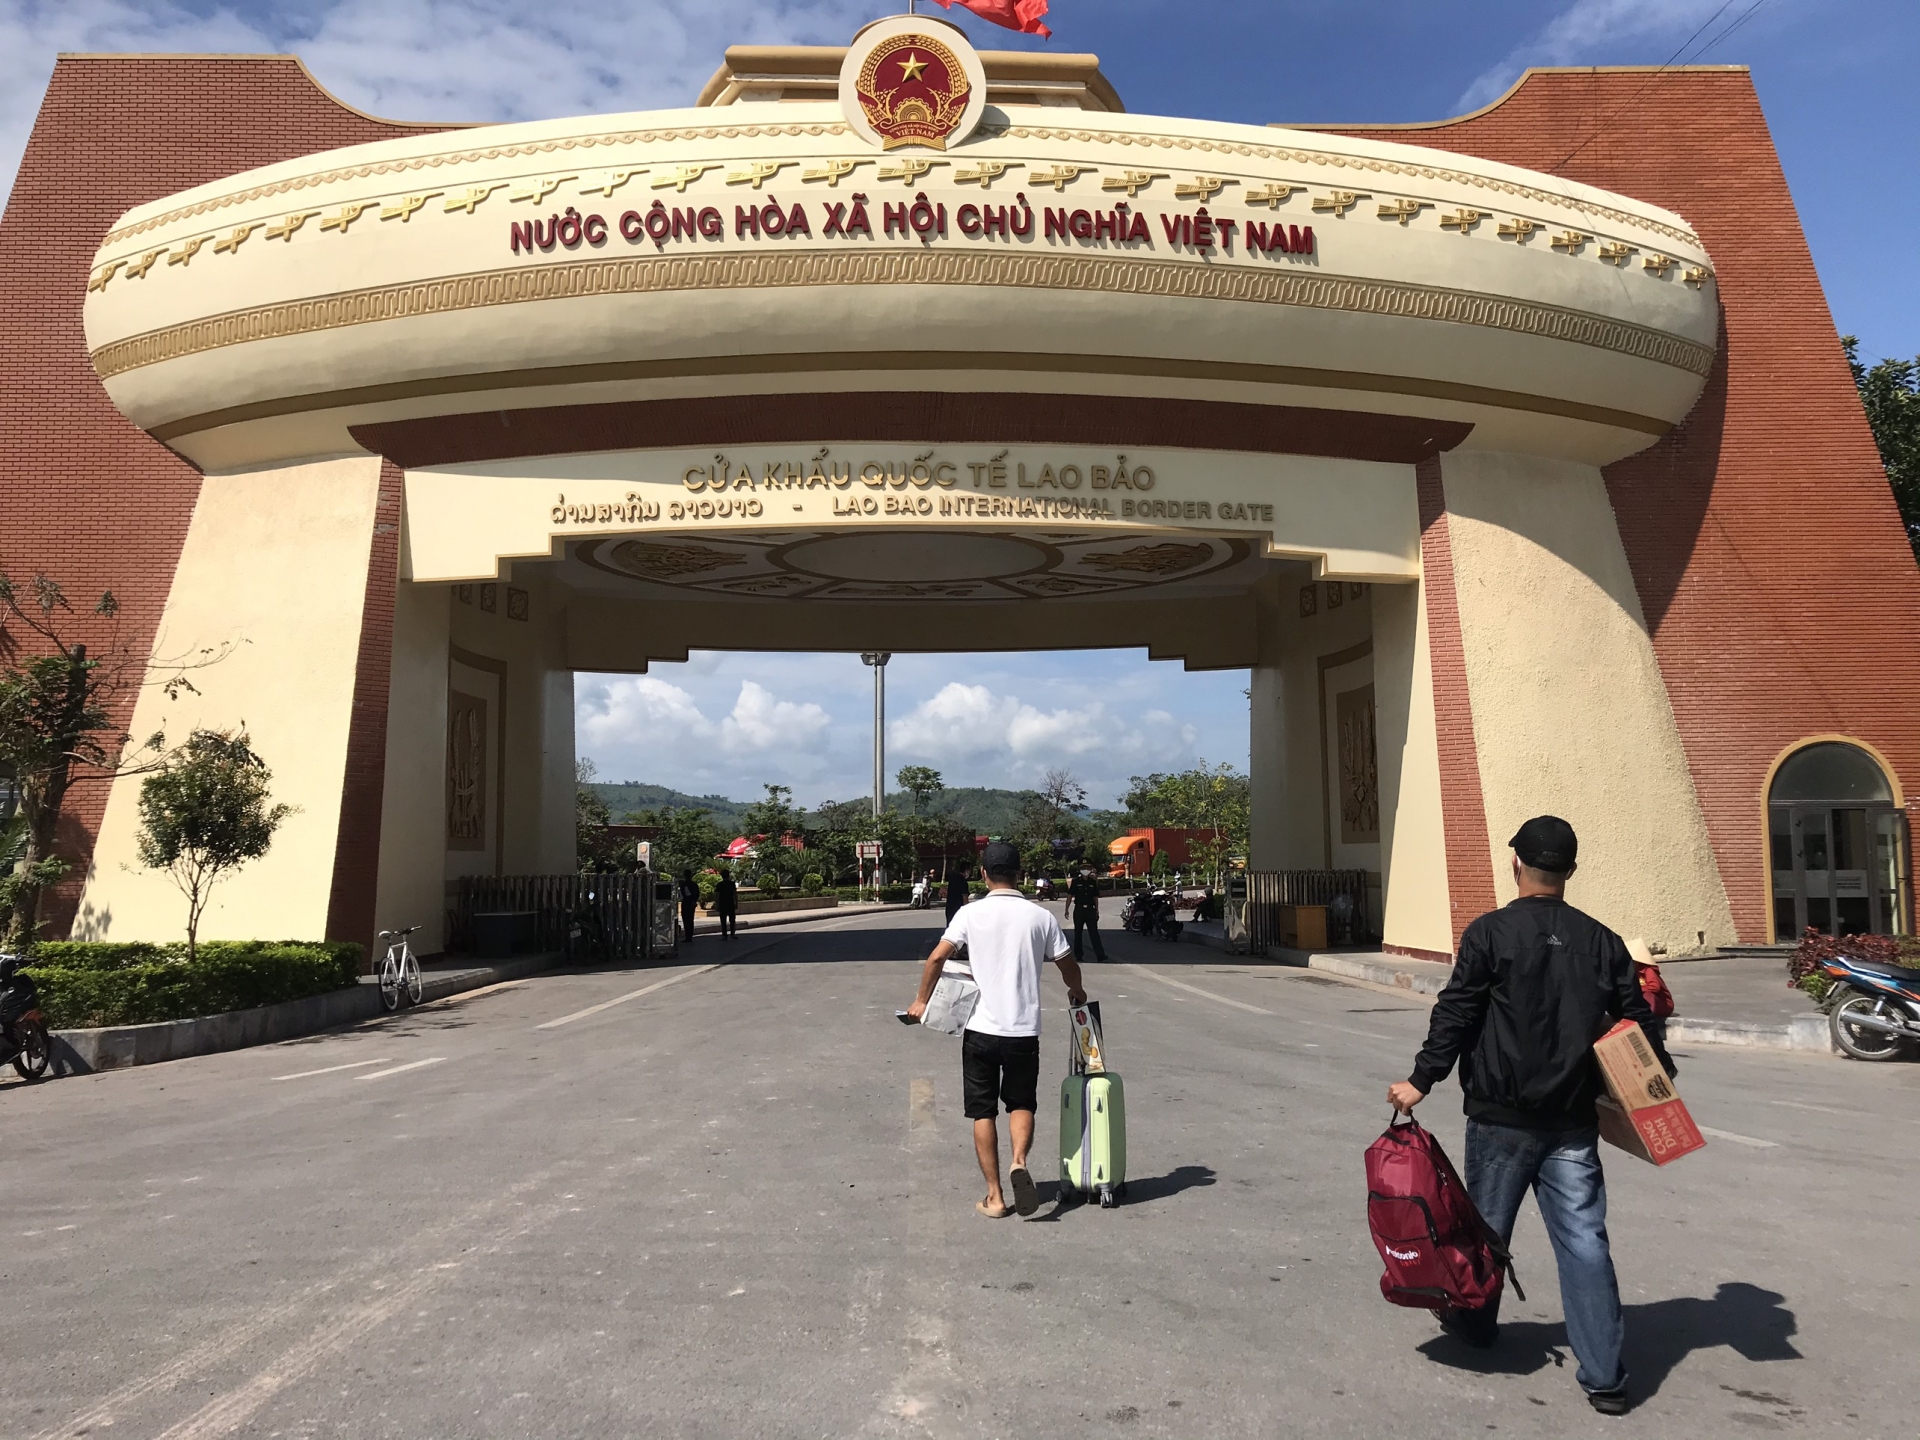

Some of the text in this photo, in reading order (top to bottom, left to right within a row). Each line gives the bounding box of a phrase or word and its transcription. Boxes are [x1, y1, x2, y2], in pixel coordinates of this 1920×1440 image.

[510, 192, 1314, 255] NƯỚC CỘNG HÒA XÃ HỘI CHỦ NGHĨA VIỆT NAM
[682, 446, 1156, 491] CỬA KHẨU QUỐC TẾ LAO BẢO
[832, 496, 878, 515] LAO
[884, 495, 932, 514] BAO
[939, 495, 1115, 517] INTERNATIONAL
[1121, 499, 1212, 519] BORDER
[1217, 502, 1275, 522] GATE
